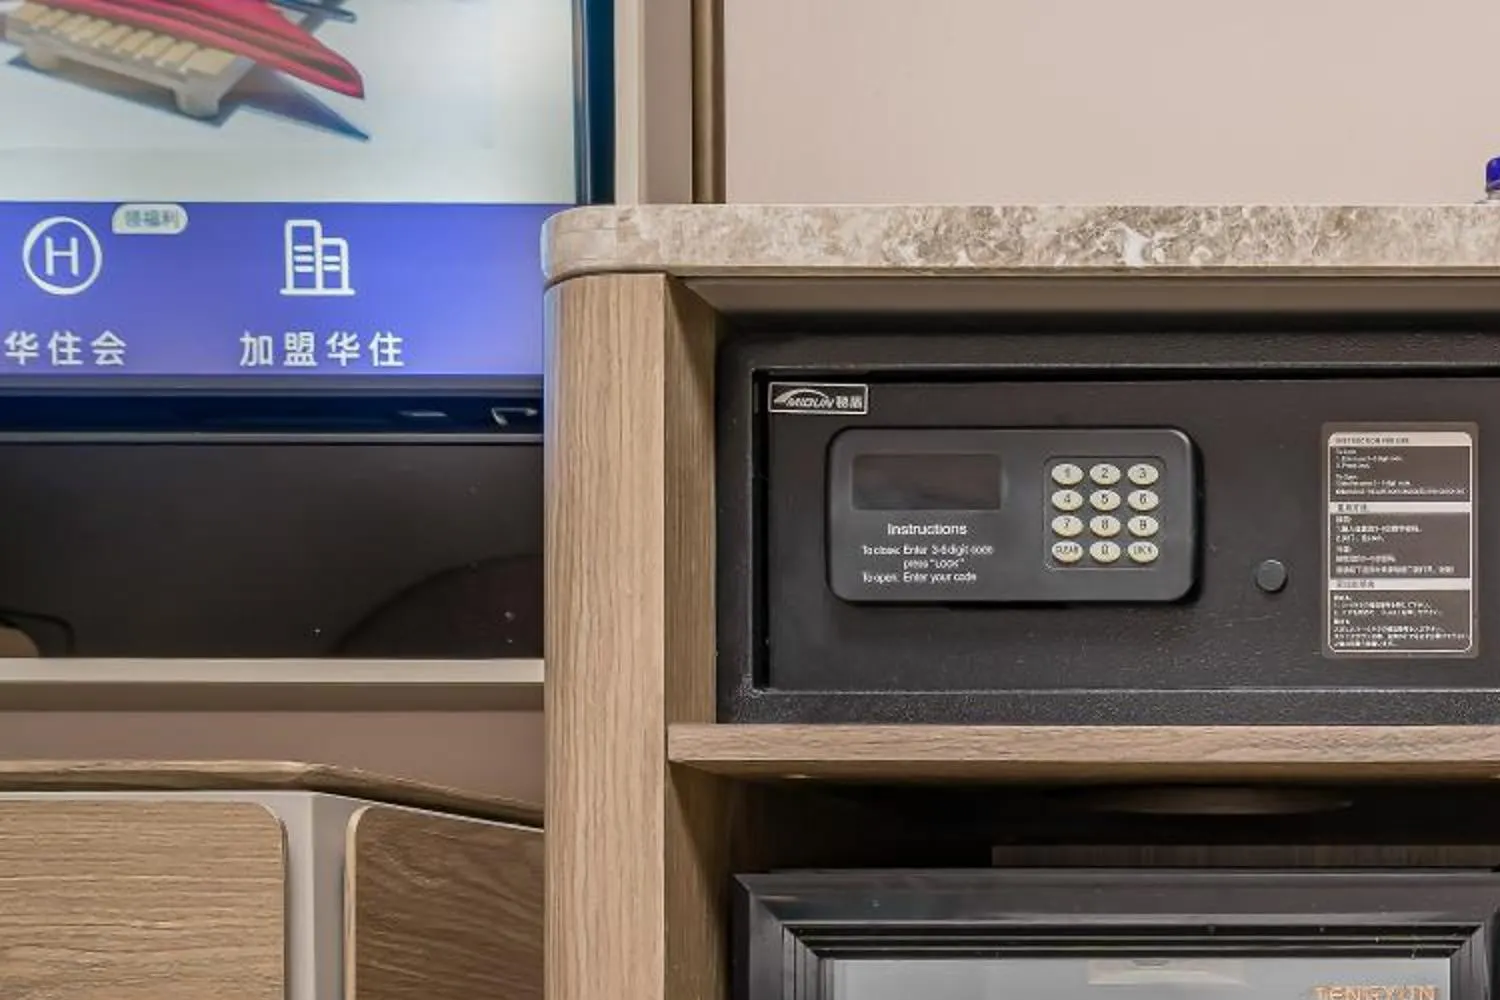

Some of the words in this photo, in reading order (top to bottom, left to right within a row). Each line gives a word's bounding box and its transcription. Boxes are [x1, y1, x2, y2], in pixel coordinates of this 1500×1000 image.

[4, 330, 127, 366] 华住会
[239, 330, 404, 367] 加盟华住
[887, 523, 968, 535] Instructions
